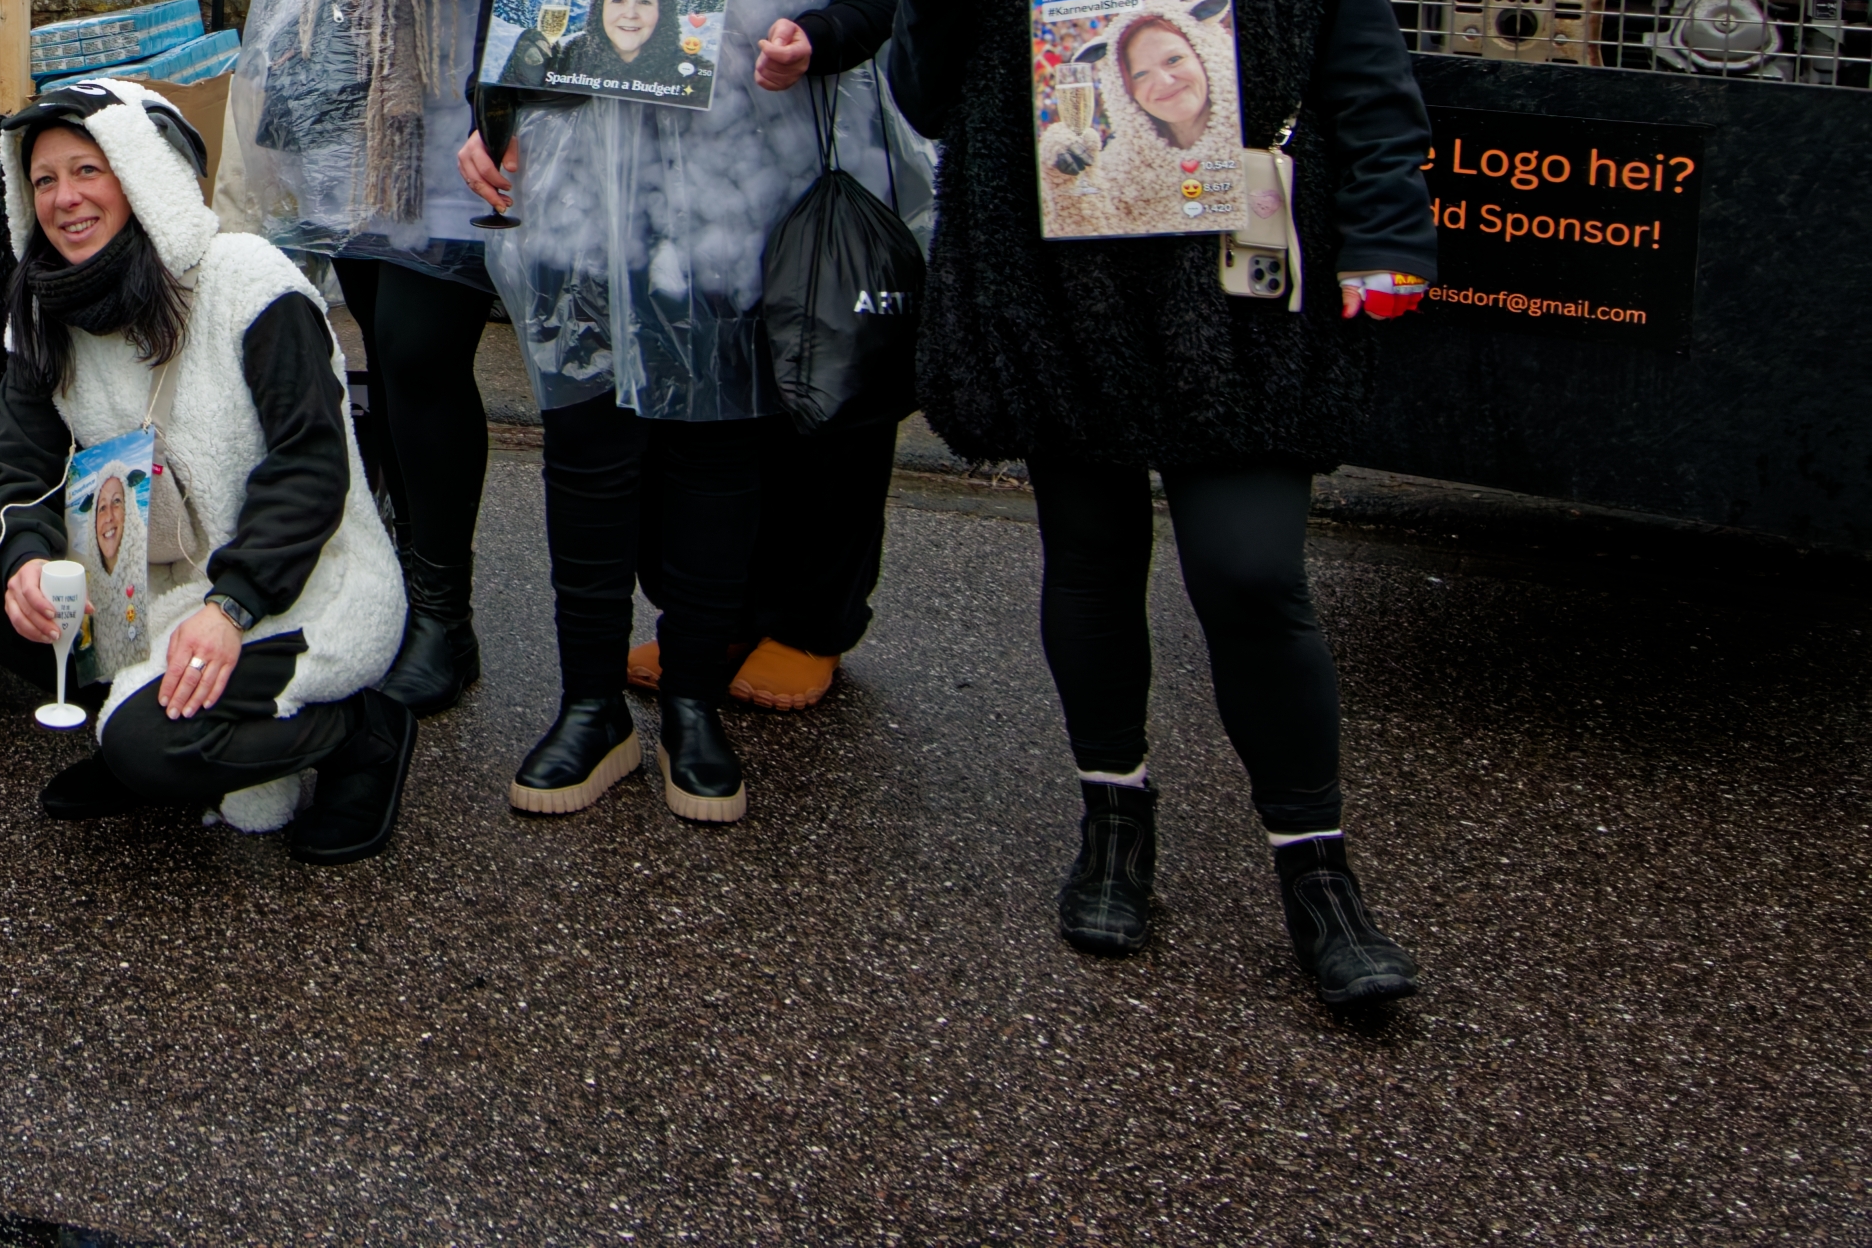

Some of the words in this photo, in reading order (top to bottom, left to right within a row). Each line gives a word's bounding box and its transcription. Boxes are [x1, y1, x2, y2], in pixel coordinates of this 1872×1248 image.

[545, 71, 601, 90] Sparkling
[603, 79, 619, 89] on
[621, 82, 629, 90] a
[632, 80, 681, 96] Budget!
[697, 69, 713, 77] 250
[1453, 138, 1571, 190] Logo
[1589, 148, 1695, 193] hei?
[1479, 204, 1661, 249] Sponsor!
[1428, 285, 1646, 325] eisdorf@gmail.com
